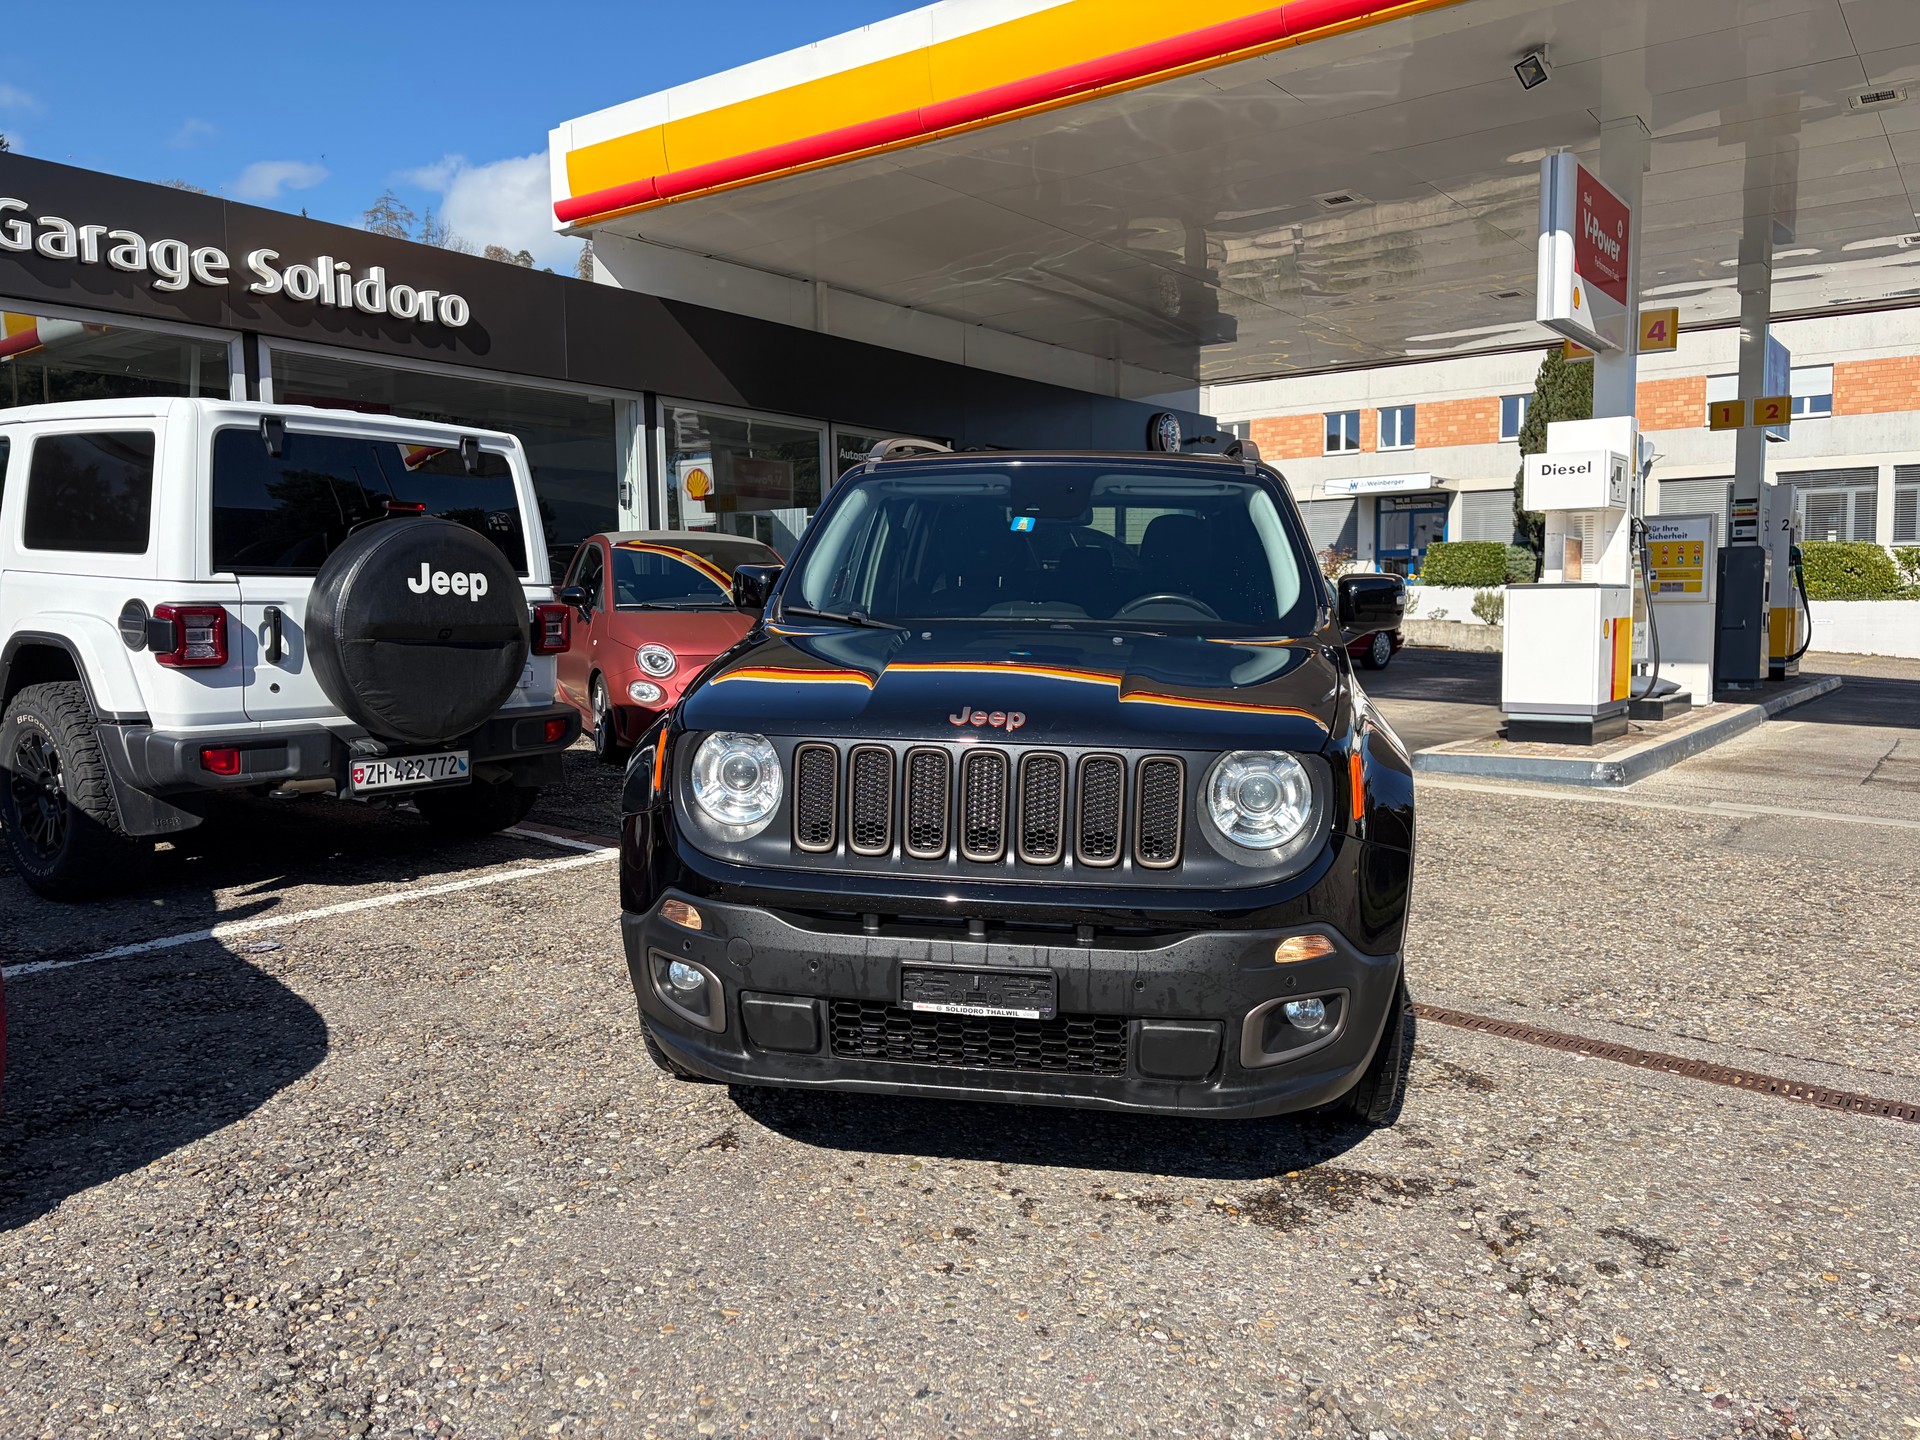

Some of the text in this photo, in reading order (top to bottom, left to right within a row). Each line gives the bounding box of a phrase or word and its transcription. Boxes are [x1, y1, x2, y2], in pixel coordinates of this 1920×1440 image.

[1583, 207, 1621, 262] V-Power
[0, 196, 471, 328] Garage Solidoro
[1646, 320, 1667, 342] 4
[1722, 407, 1730, 423] 1
[1765, 404, 1779, 420] 2
[1541, 461, 1591, 476] Diesel
[1662, 524, 1679, 532] Ihre
[1781, 519, 1790, 531] 2
[1648, 532, 1688, 540] Sicherheit
[407, 562, 488, 602] Jeep
[949, 706, 1026, 732] Jeep
[945, 1006, 984, 1015] SOLIDORO
[986, 1009, 1020, 1017] THALWIL
